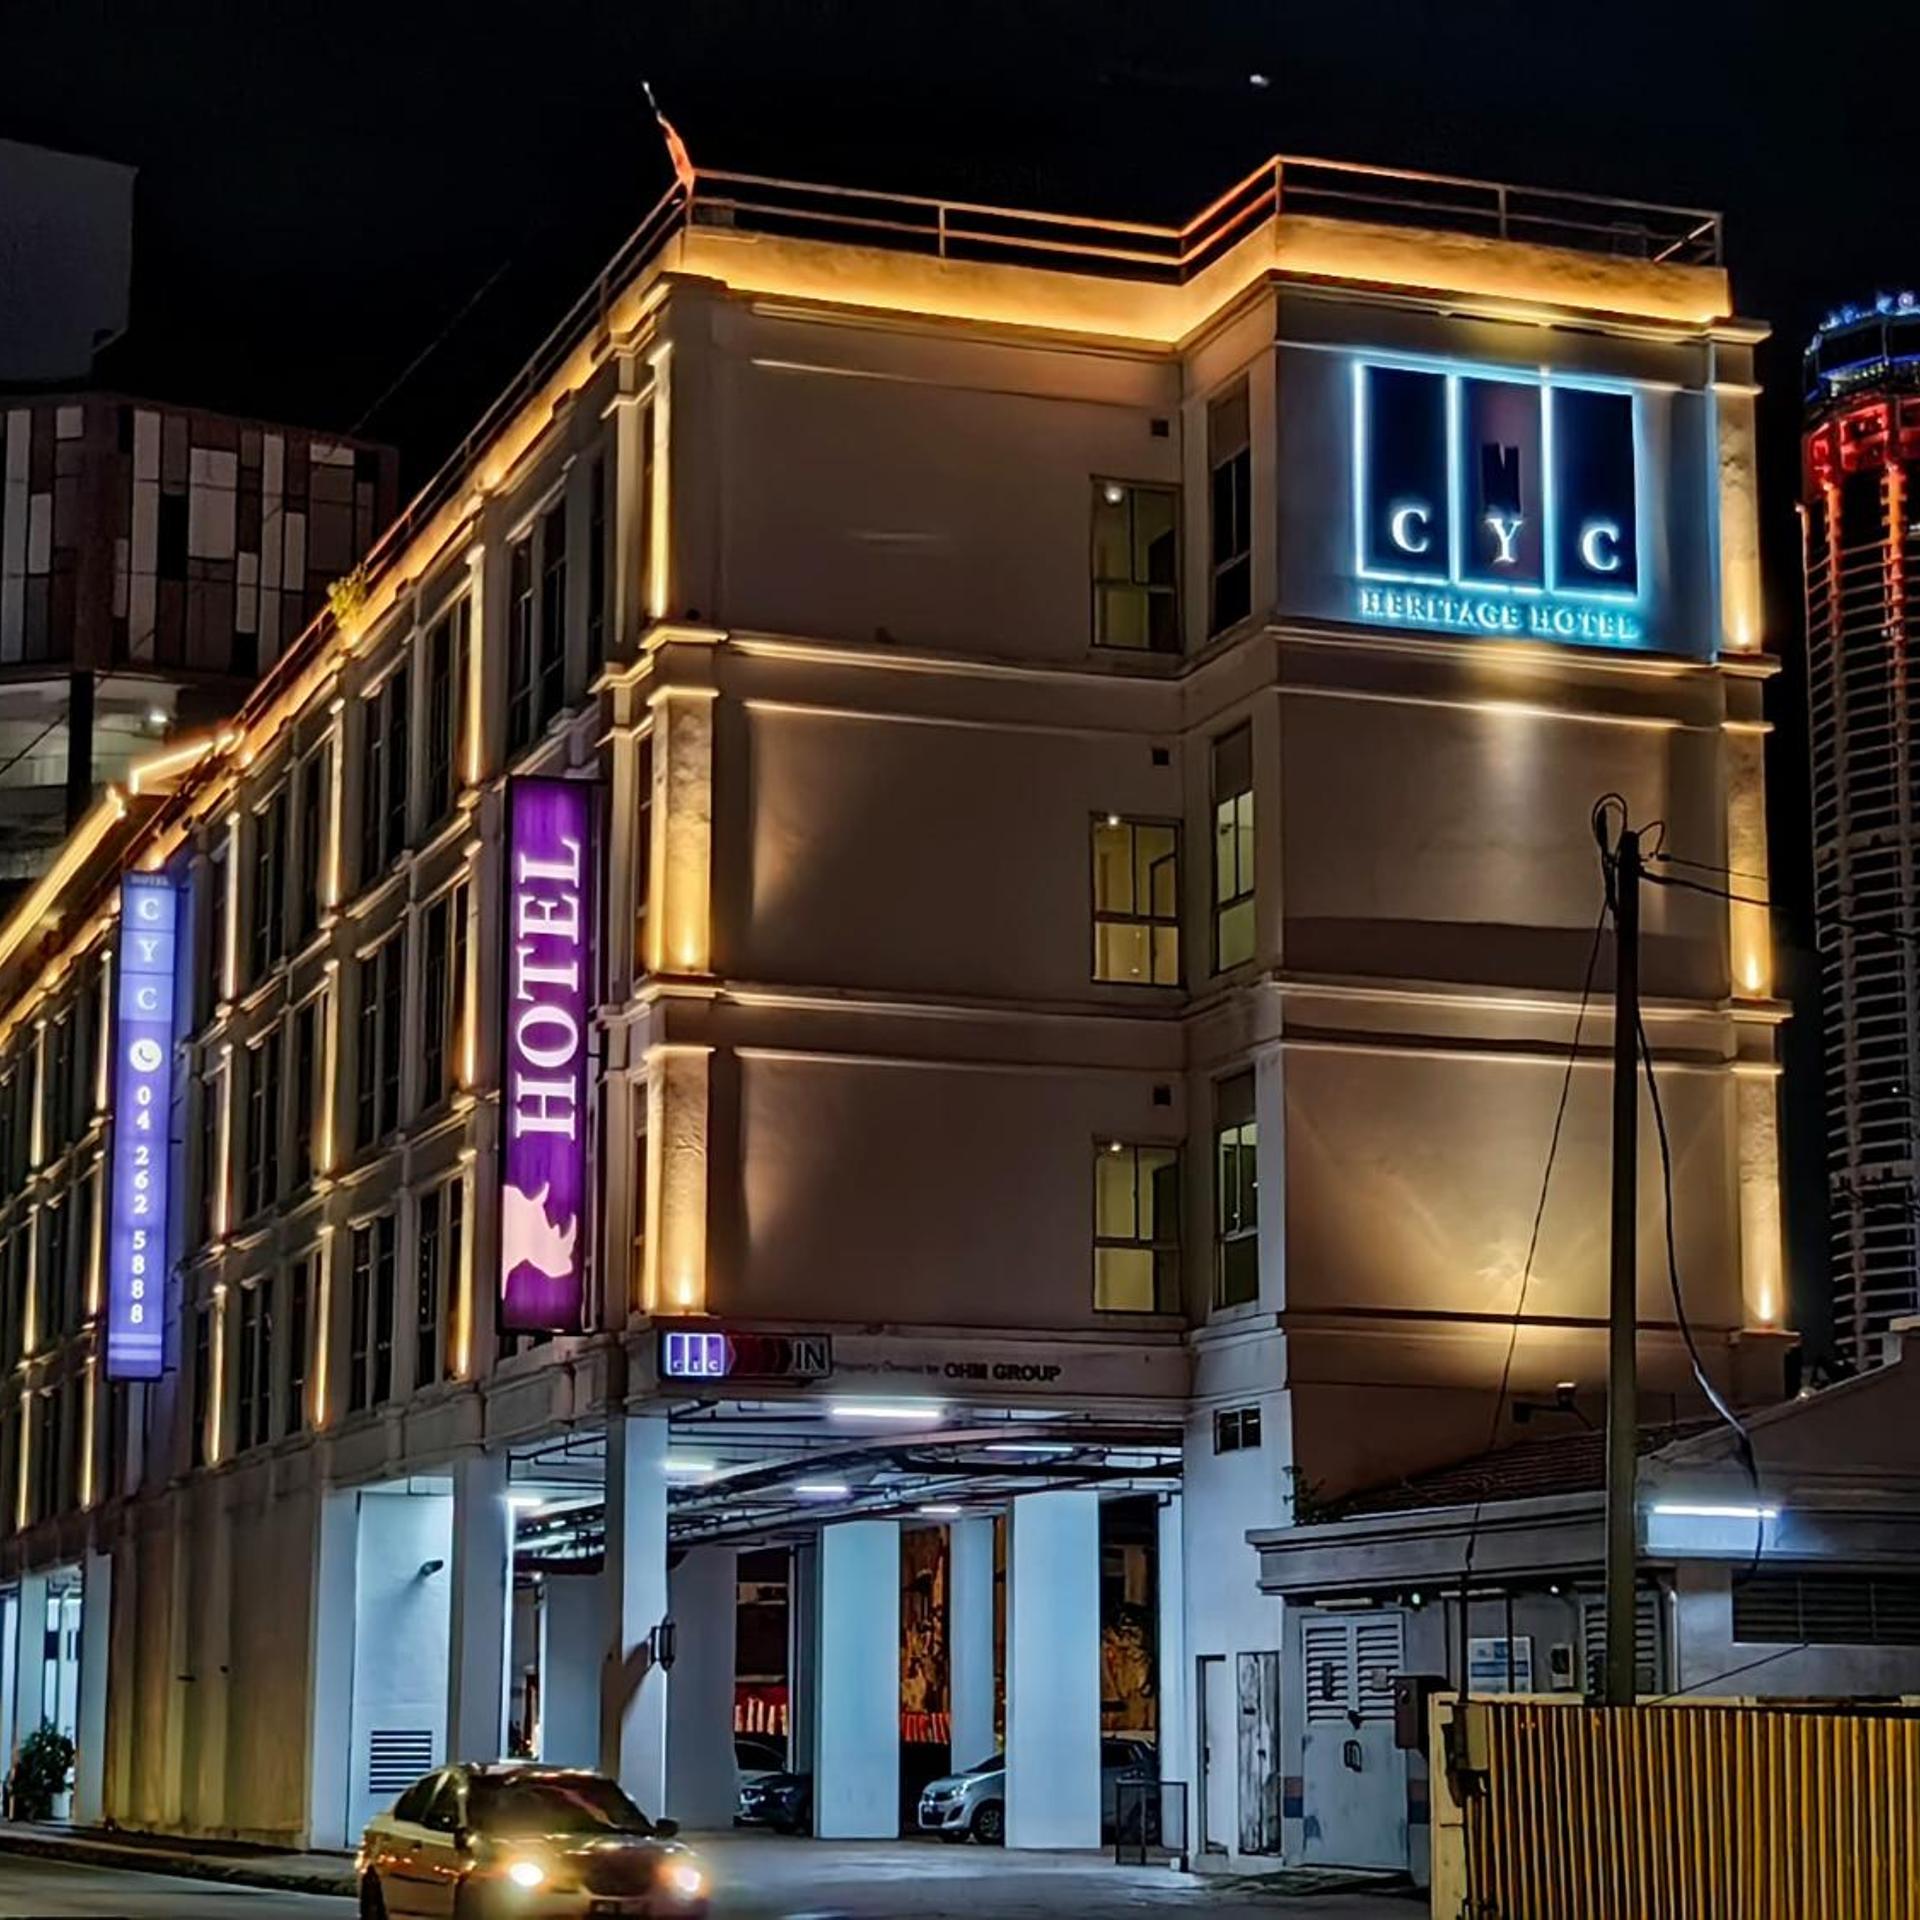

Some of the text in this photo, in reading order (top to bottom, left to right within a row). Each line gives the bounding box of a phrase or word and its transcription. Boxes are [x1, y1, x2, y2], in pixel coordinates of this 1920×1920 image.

[1361, 591, 1638, 640] HERITAGE HOTEL
[516, 838, 580, 1140] HOTEL
[992, 1363, 1061, 1382] GROUP
